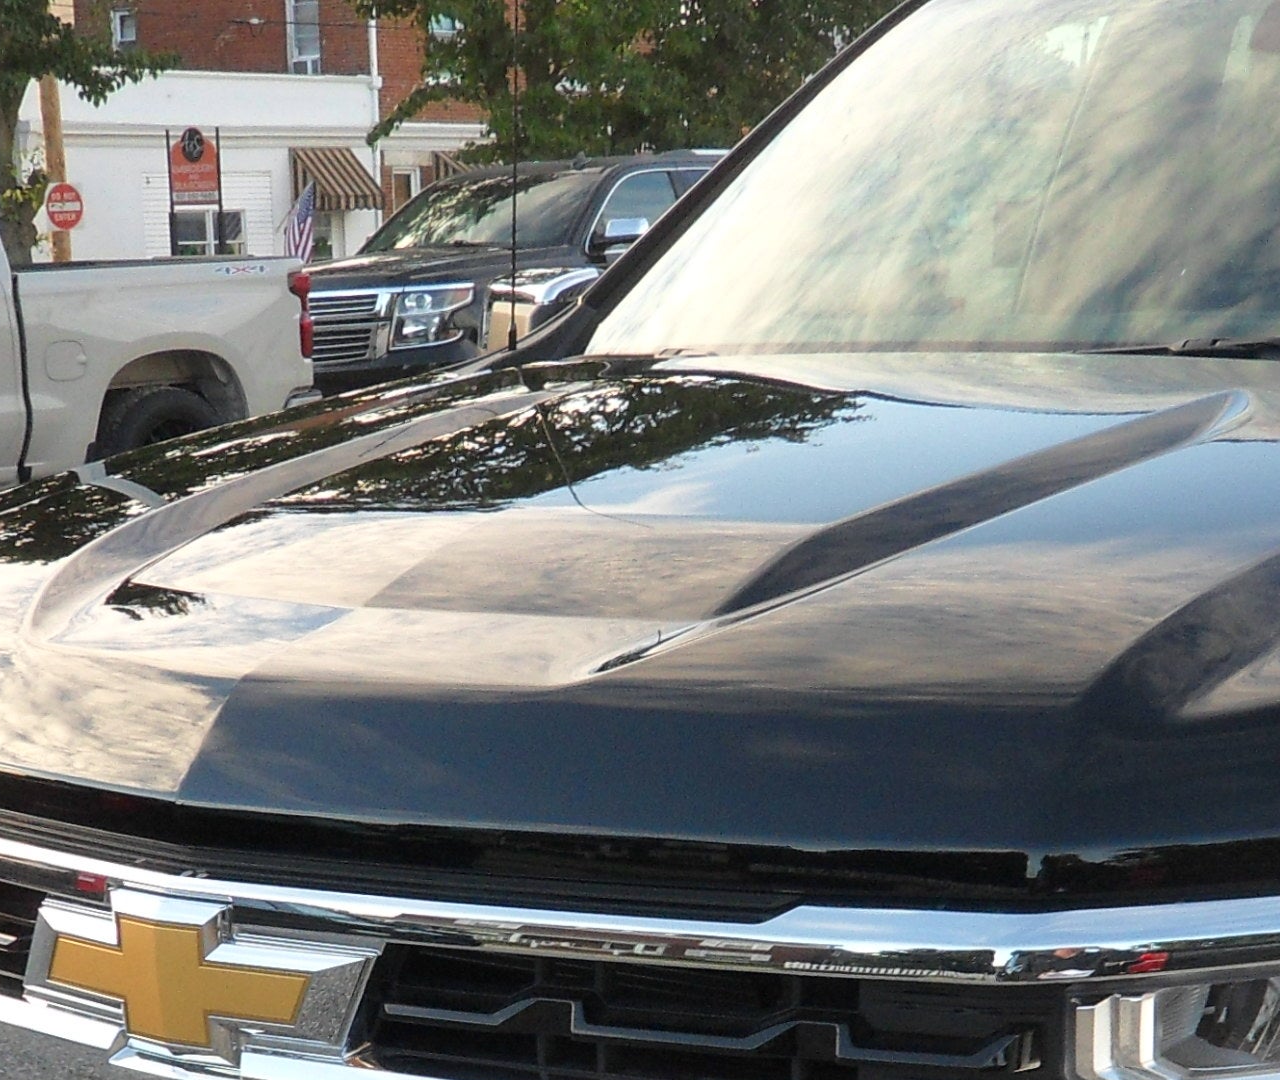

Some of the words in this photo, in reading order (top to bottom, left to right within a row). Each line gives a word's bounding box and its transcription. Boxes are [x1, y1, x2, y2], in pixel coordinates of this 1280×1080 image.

[51, 192, 61, 201] DO
[63, 192, 77, 201] NOT
[53, 212, 76, 222] ENTER
